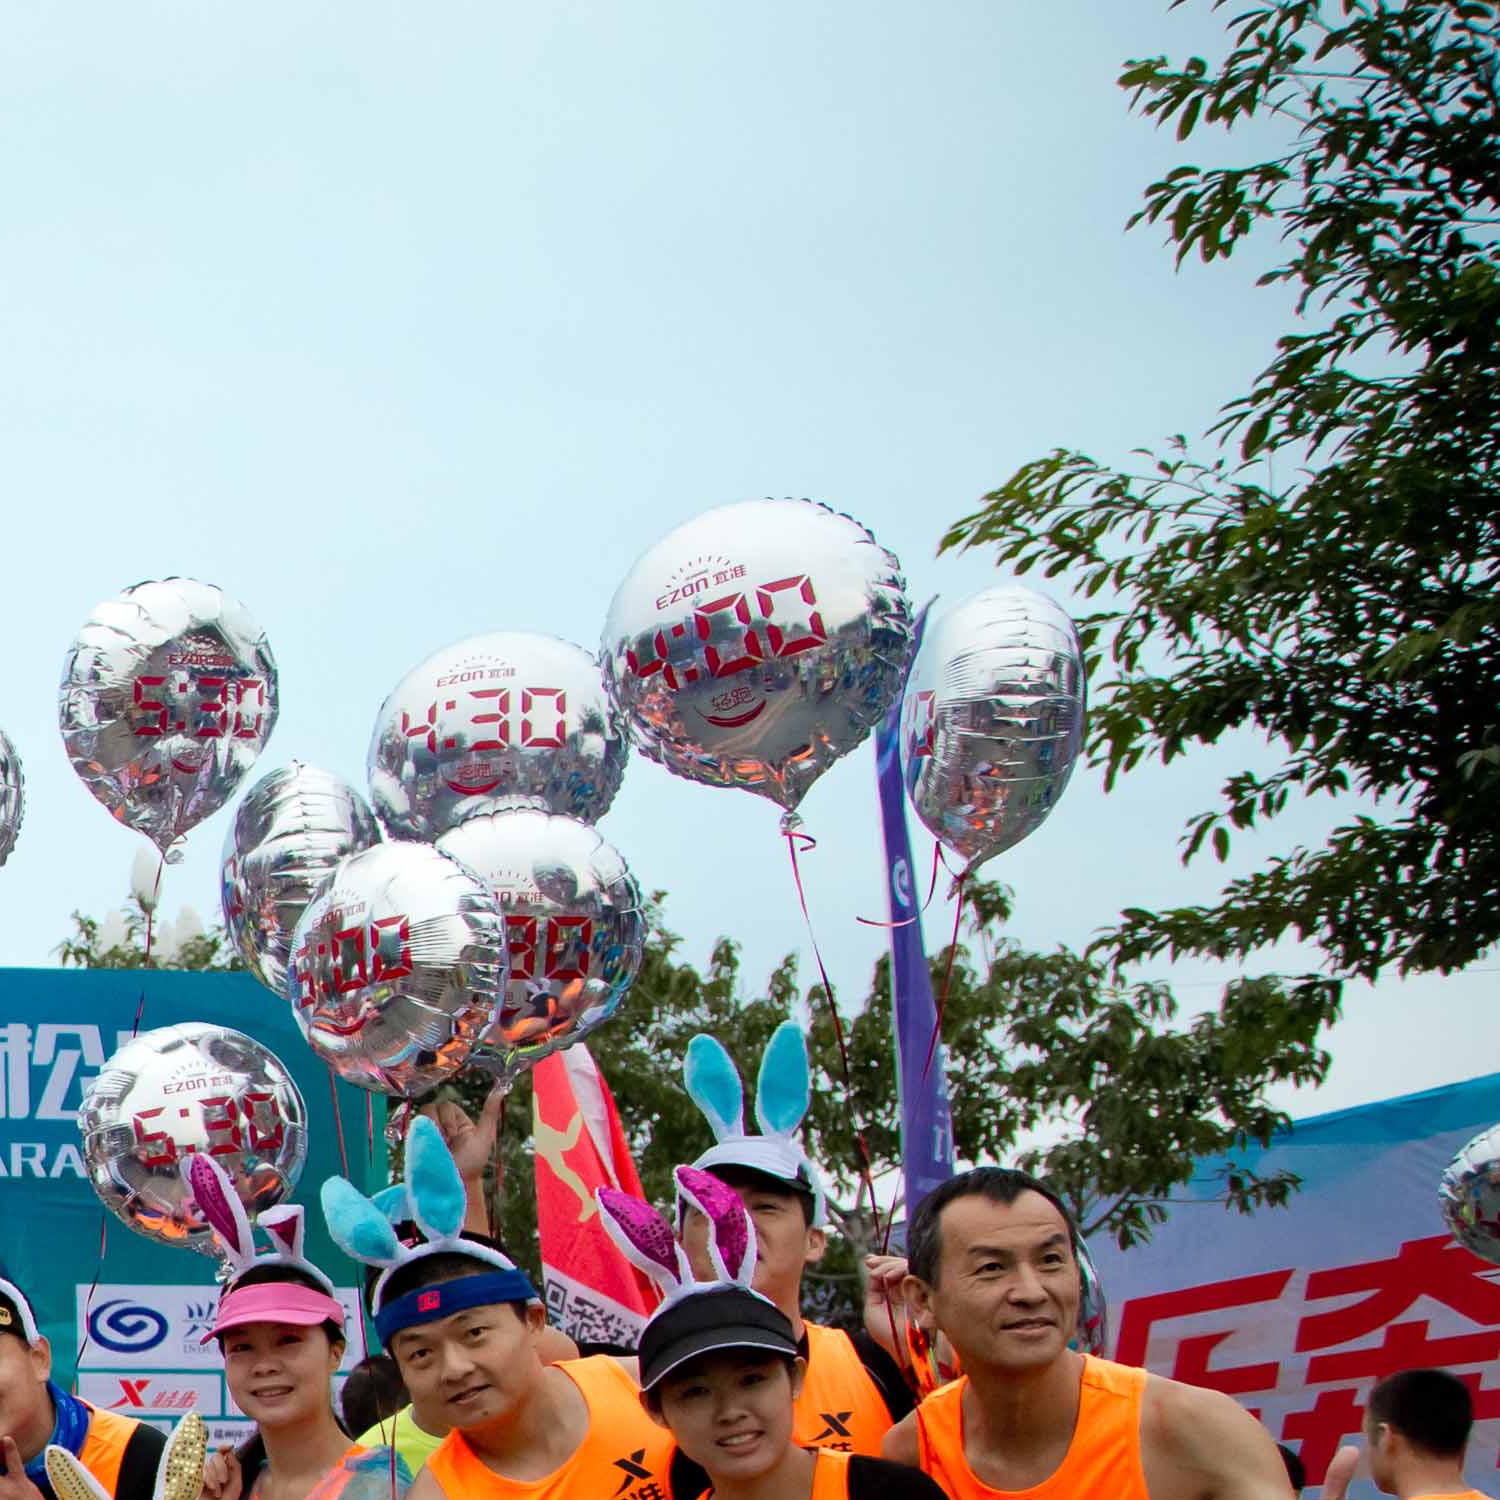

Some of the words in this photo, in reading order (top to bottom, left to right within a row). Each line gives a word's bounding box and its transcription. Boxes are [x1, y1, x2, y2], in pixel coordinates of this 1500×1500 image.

[656, 577, 710, 610] EZON
[626, 574, 828, 691] 4:00
[134, 676, 264, 738] 5:30
[436, 670, 485, 687] EZON
[402, 687, 566, 753] 4:30
[505, 915, 593, 980] 30
[163, 1078, 206, 1095] EZON
[134, 1092, 283, 1167] 5:30
